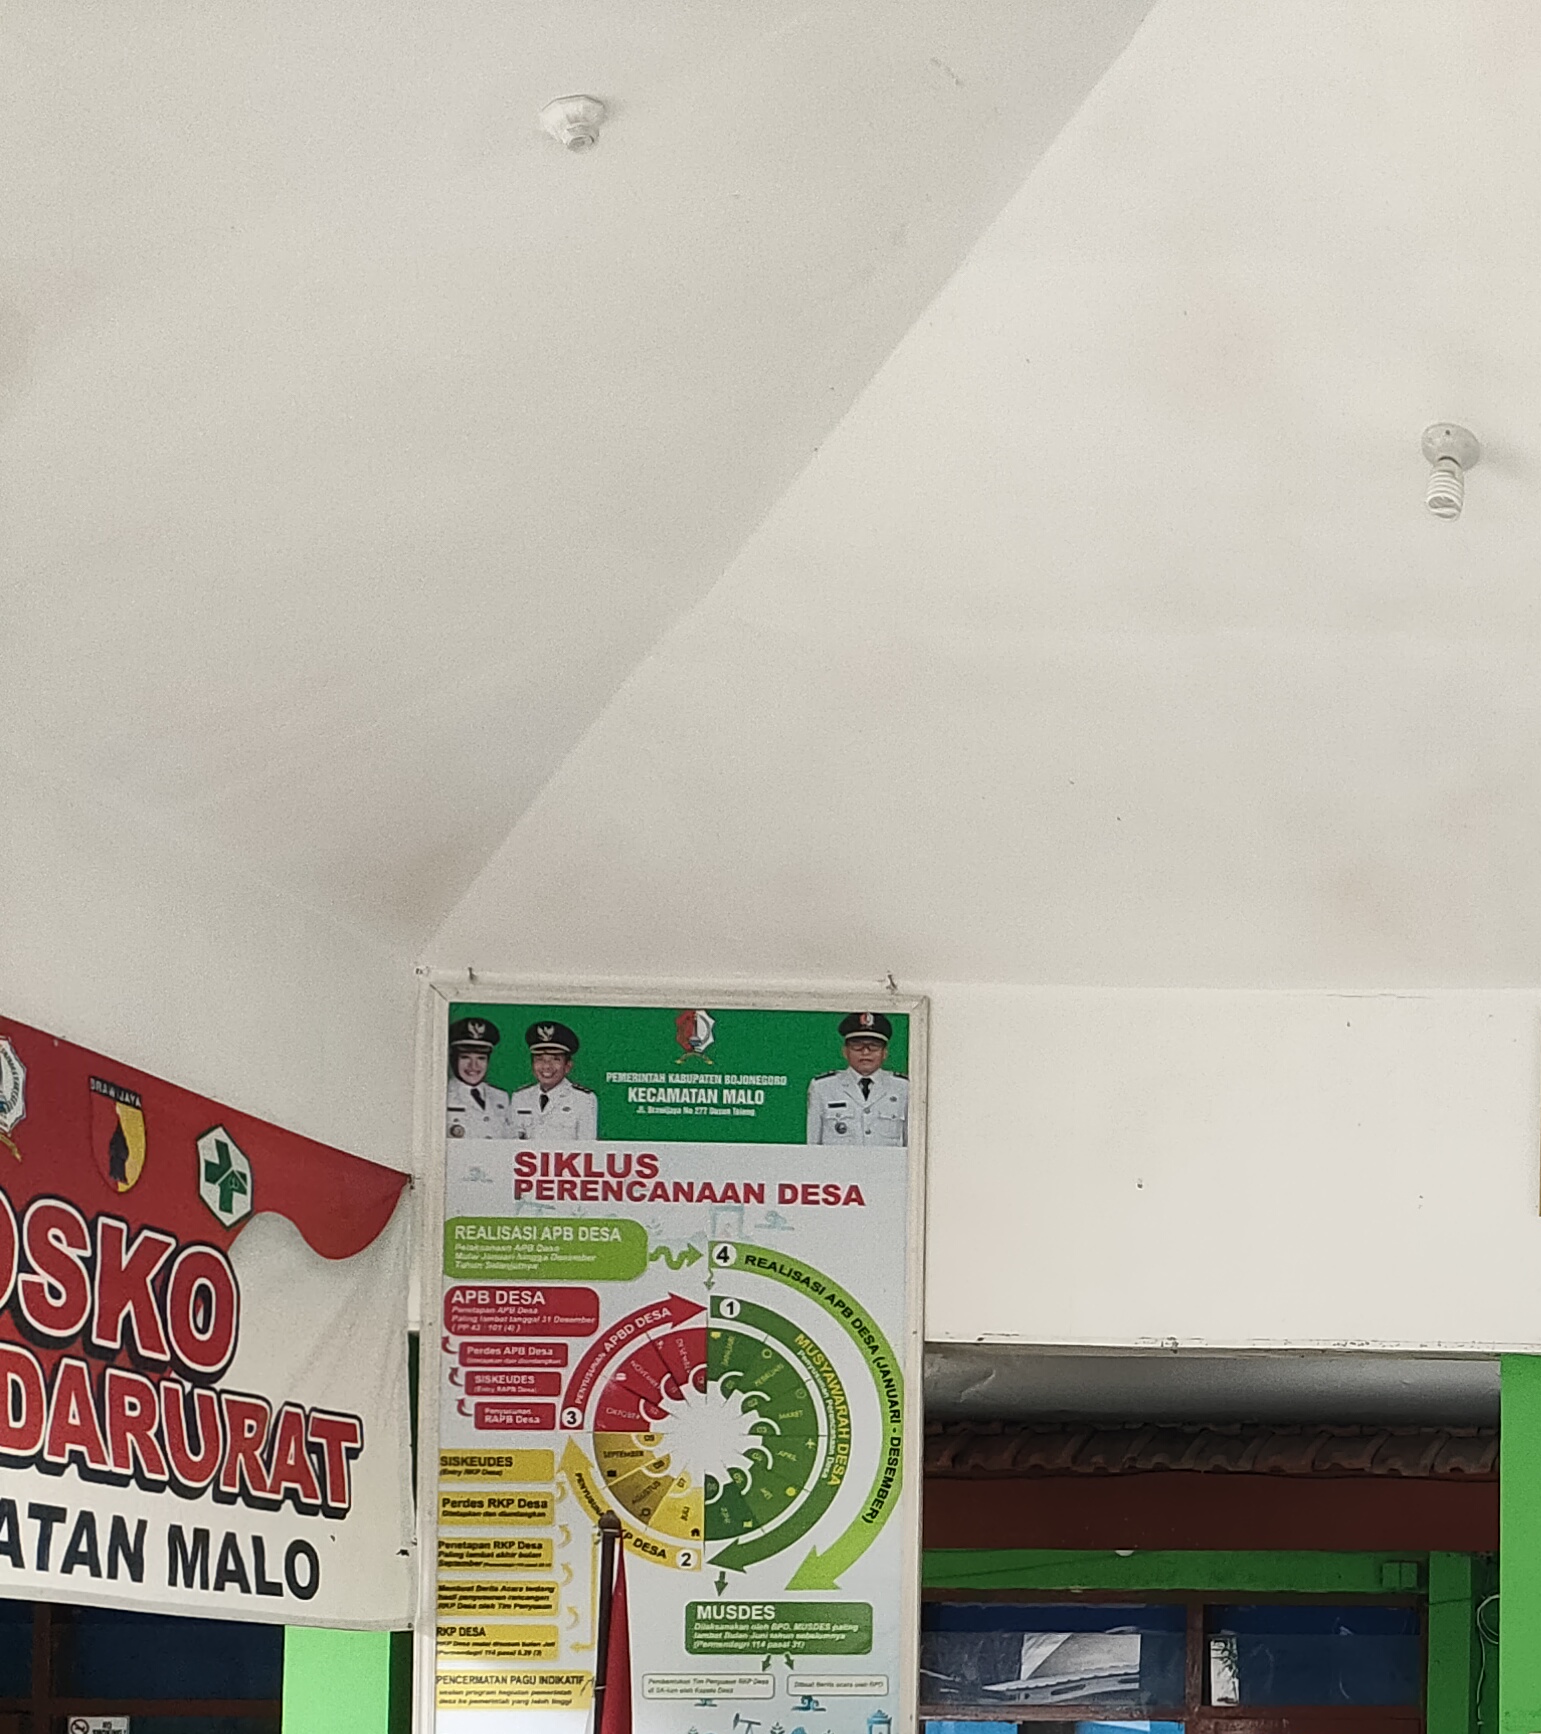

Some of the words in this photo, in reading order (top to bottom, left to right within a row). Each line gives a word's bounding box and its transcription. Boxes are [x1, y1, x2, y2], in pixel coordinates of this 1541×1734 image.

[606, 1072, 666, 1083] PEMERINTAH
[668, 1073, 722, 1085] KABUPATEN
[723, 1074, 787, 1086] BOJONEGORO
[628, 1087, 718, 1104] KECAMATAN
[722, 1089, 765, 1105] MALO
[513, 1152, 660, 1179] SIKLUS
[513, 1180, 765, 1204] PERENCANAAN
[778, 1184, 866, 1206] DESA
[455, 1225, 536, 1240] REALISASI
[540, 1227, 574, 1241] APB
[578, 1227, 622, 1242] DESA
[716, 1246, 730, 1263] 4
[0, 1187, 239, 1375] SKO
[745, 1255, 826, 1295] REALISASI
[451, 1290, 490, 1304] APB
[495, 1291, 546, 1305] DESA
[725, 1302, 735, 1315] 1
[825, 1294, 853, 1319] APB
[604, 1325, 635, 1352] APBD
[635, 1308, 672, 1327] DESA
[852, 1318, 879, 1355] DESA
[467, 1346, 502, 1355] Perdes
[503, 1347, 526, 1355] APB
[528, 1347, 553, 1356] Desa
[474, 1375, 535, 1384] SISKEUDES
[872, 1356, 901, 1423] (JANUARI
[567, 1411, 577, 1425] 3
[795, 1334, 850, 1438] MUSYAWARAH
[828, 1443, 850, 1486] DESA
[484, 1415, 514, 1423] RAPB
[515, 1416, 541, 1424] Desa
[0, 1344, 363, 1514] DARURAT
[440, 1456, 513, 1467] SISKEUDES
[862, 1437, 901, 1523] DESEMBER)
[442, 1498, 484, 1508] Perdes
[488, 1499, 514, 1508] RKP
[518, 1499, 548, 1508] Desa
[438, 1541, 491, 1550] Penetapan
[494, 1541, 515, 1549] RKP
[518, 1541, 543, 1549] Desa
[633, 1538, 667, 1559] DESA
[168, 1524, 320, 1600] MALO
[681, 1553, 691, 1566] 2
[697, 1605, 776, 1620] MUSDES
[437, 1627, 457, 1636] RKP
[458, 1627, 486, 1636] DESA
[436, 1675, 508, 1685] PENCERMATAN
[510, 1675, 536, 1685] PAGU
[538, 1676, 584, 1685] INDIKATIF
